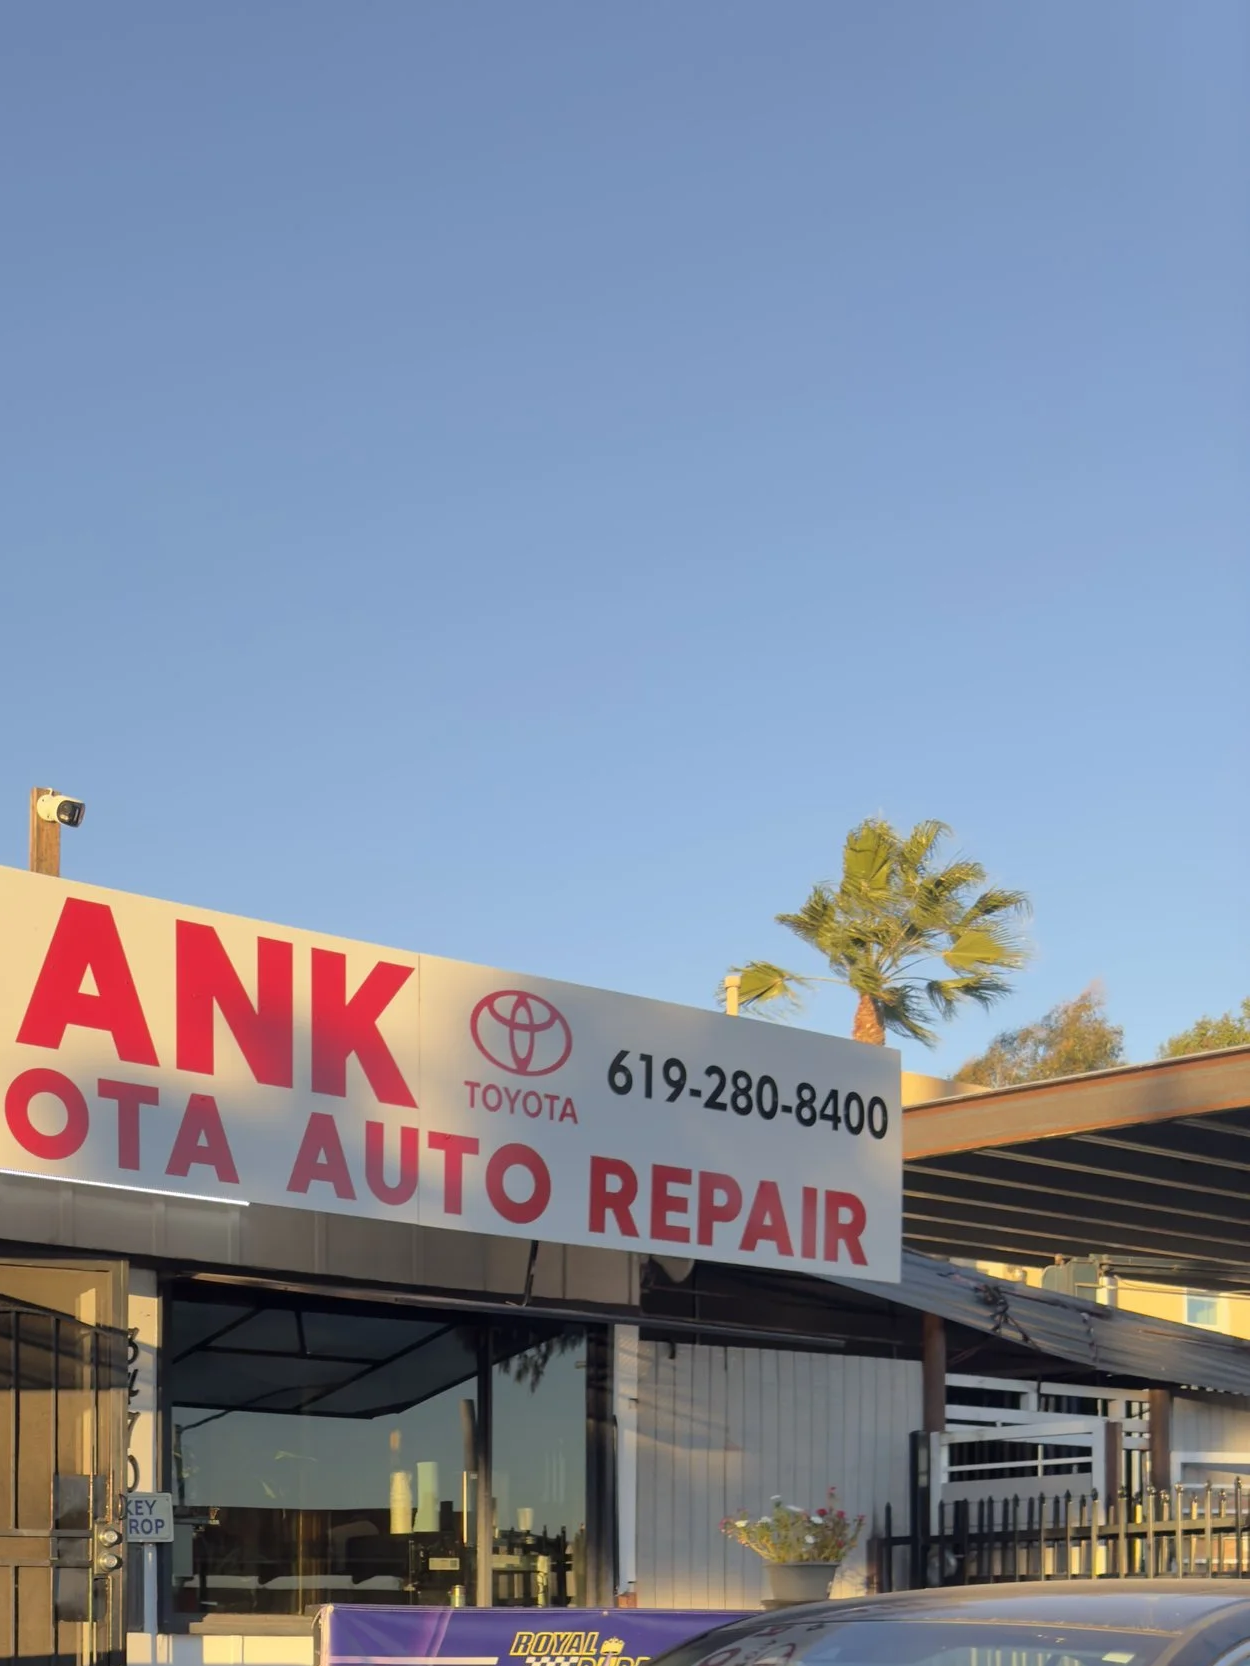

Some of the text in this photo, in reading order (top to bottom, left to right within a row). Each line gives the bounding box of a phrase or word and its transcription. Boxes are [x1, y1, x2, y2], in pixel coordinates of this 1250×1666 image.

[463, 1079, 579, 1125] TOYOTA
[606, 1048, 889, 1141] 619-280-8400
[285, 1110, 553, 1225] AUTO
[587, 1154, 870, 1267] REPAIR
[126, 1499, 157, 1515] KEY
[129, 1518, 165, 1535] ROP
[508, 1631, 600, 1656] ROYAL
